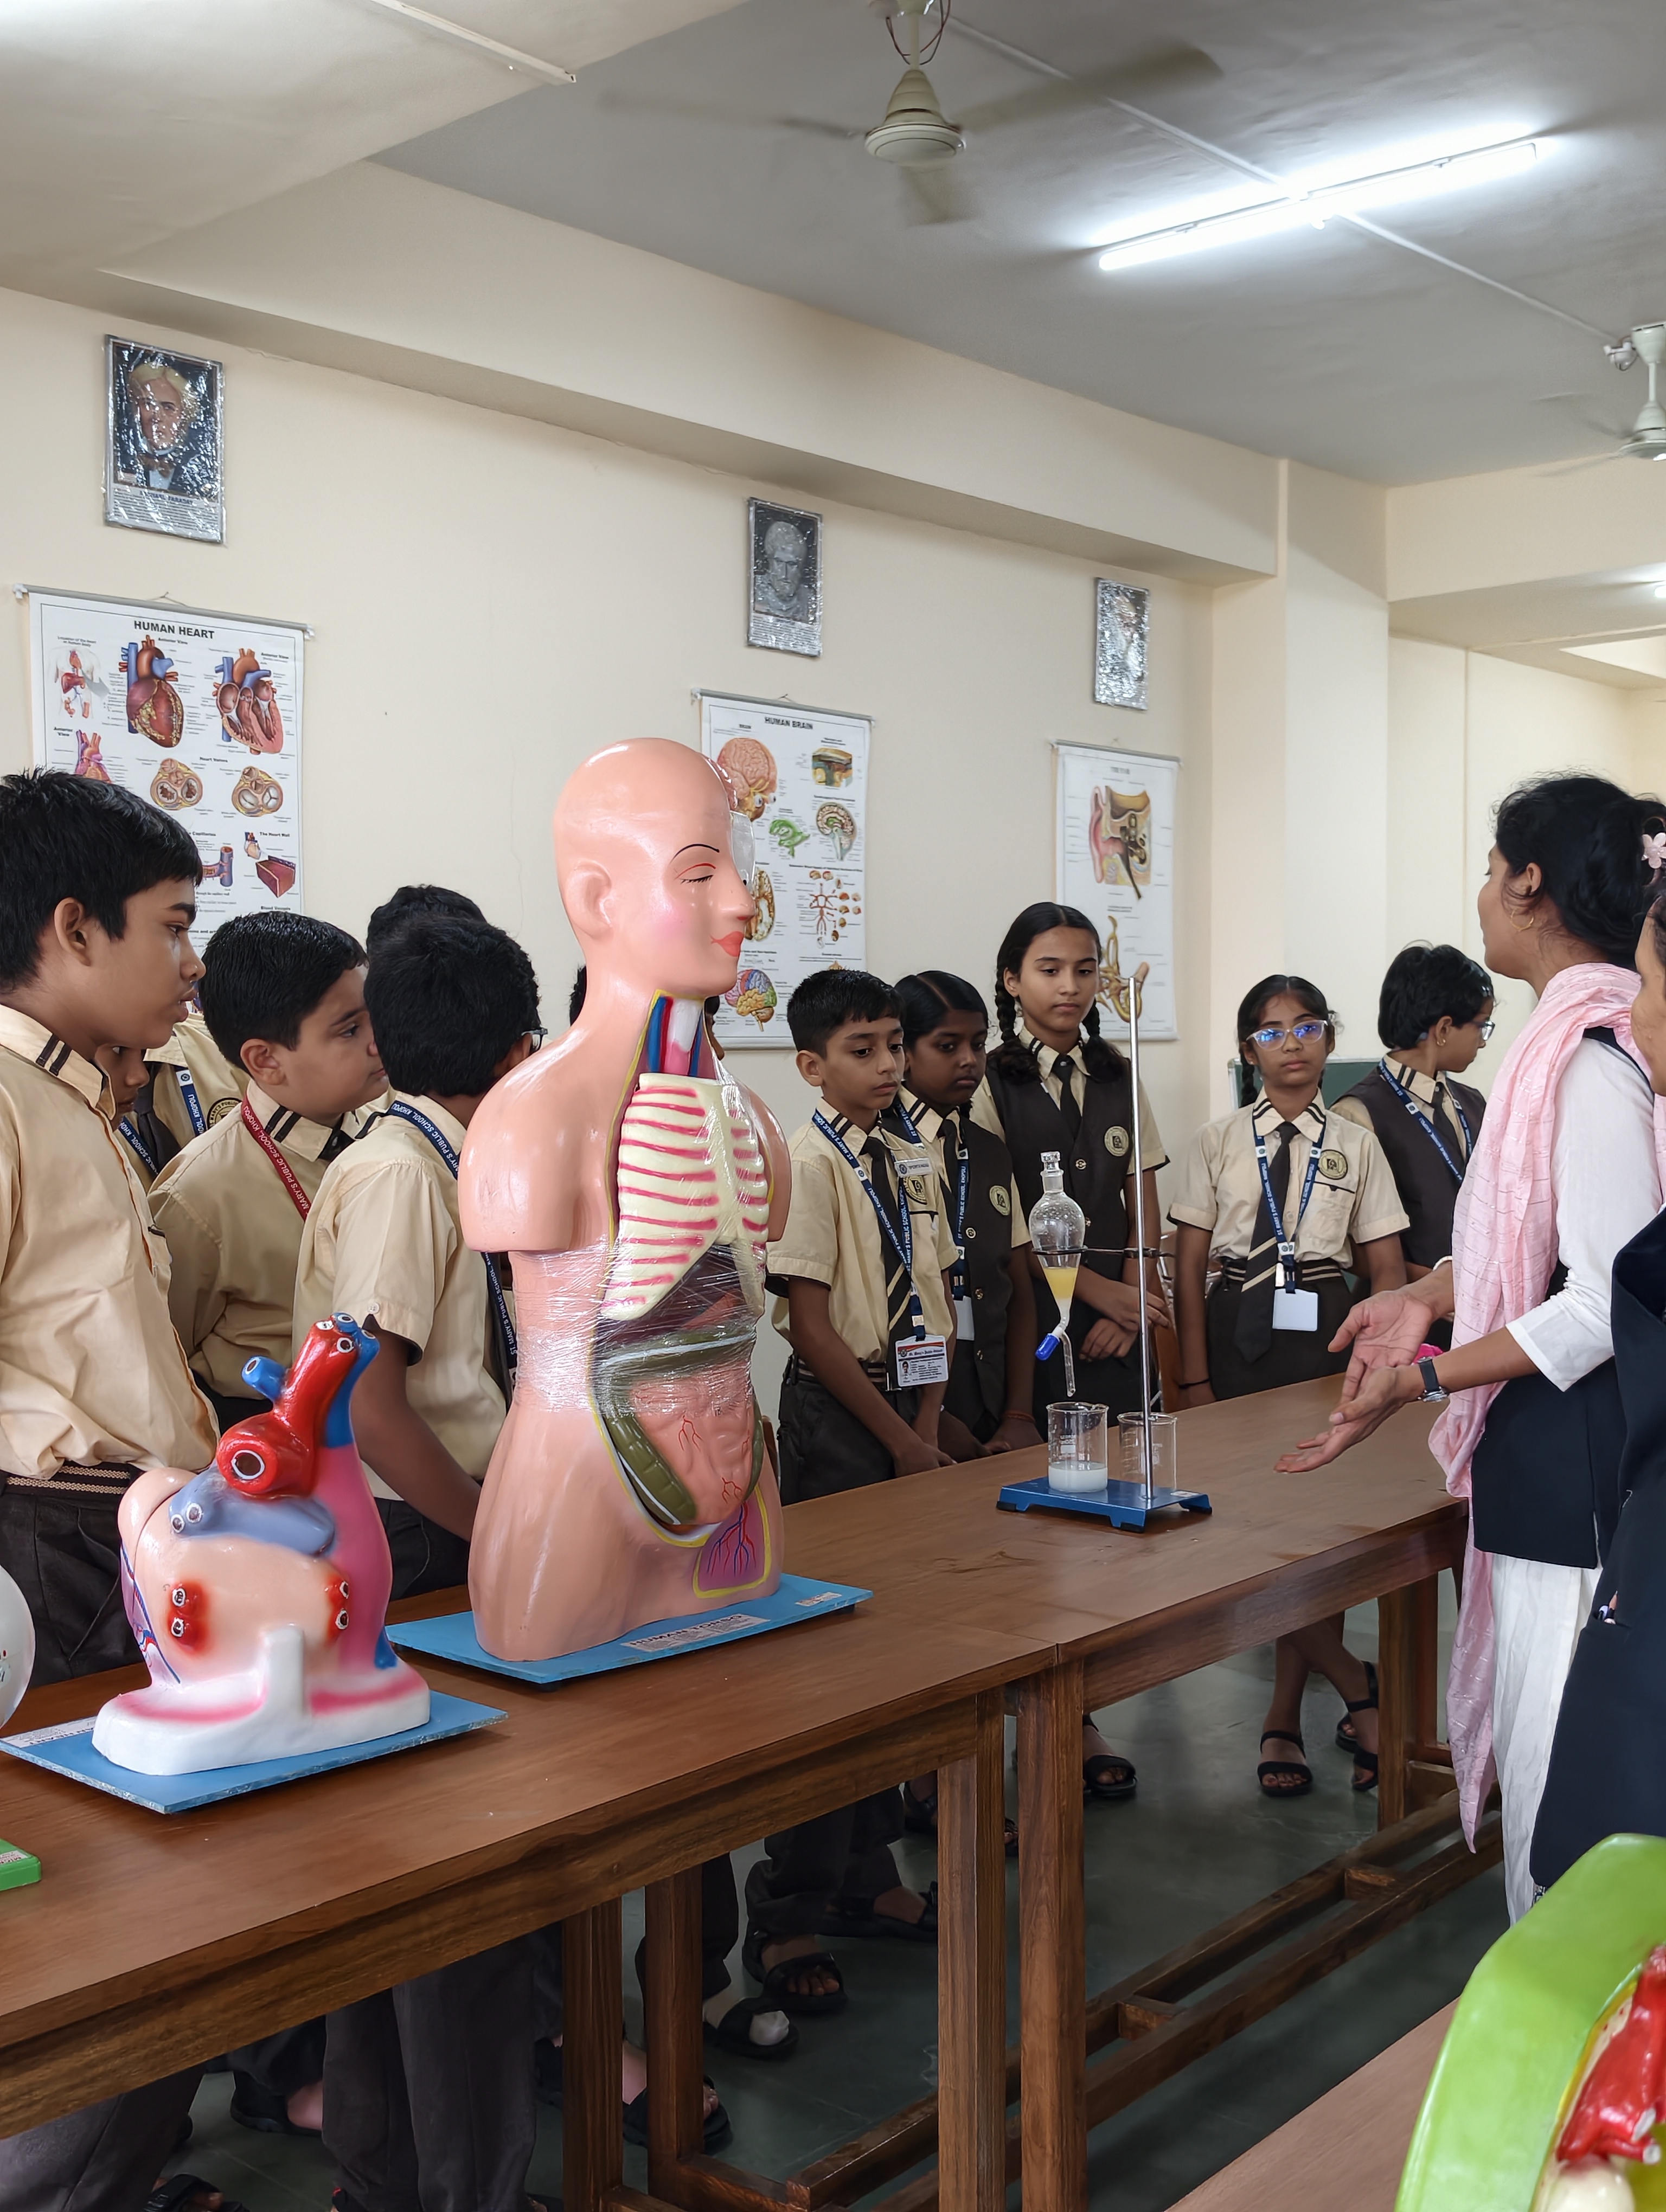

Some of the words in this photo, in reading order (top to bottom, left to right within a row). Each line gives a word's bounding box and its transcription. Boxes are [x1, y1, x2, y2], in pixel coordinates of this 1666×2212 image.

[134, 620, 175, 634] HUMAN
[179, 626, 215, 639] HEART
[765, 717, 791, 726] HUMAN
[792, 721, 813, 730] BRAIN
[188, 1094, 201, 1118] KHOPOLI
[244, 1105, 260, 1131] KHOPOLI
[196, 1118, 204, 1134] OOL,
[258, 1130, 280, 1158] SCHOOL,
[432, 1131, 450, 1154] PUBLIC
[276, 1158, 294, 1183] PUBLIC
[446, 1153, 459, 1172] ARY'S
[291, 1183, 310, 1210] MARY'S
[497, 1295, 507, 1319] PUBLIC
[504, 1319, 514, 1345] MARY'S
[630, 1630, 688, 1645] HUMAN
[692, 1615, 742, 1630] TORSO
